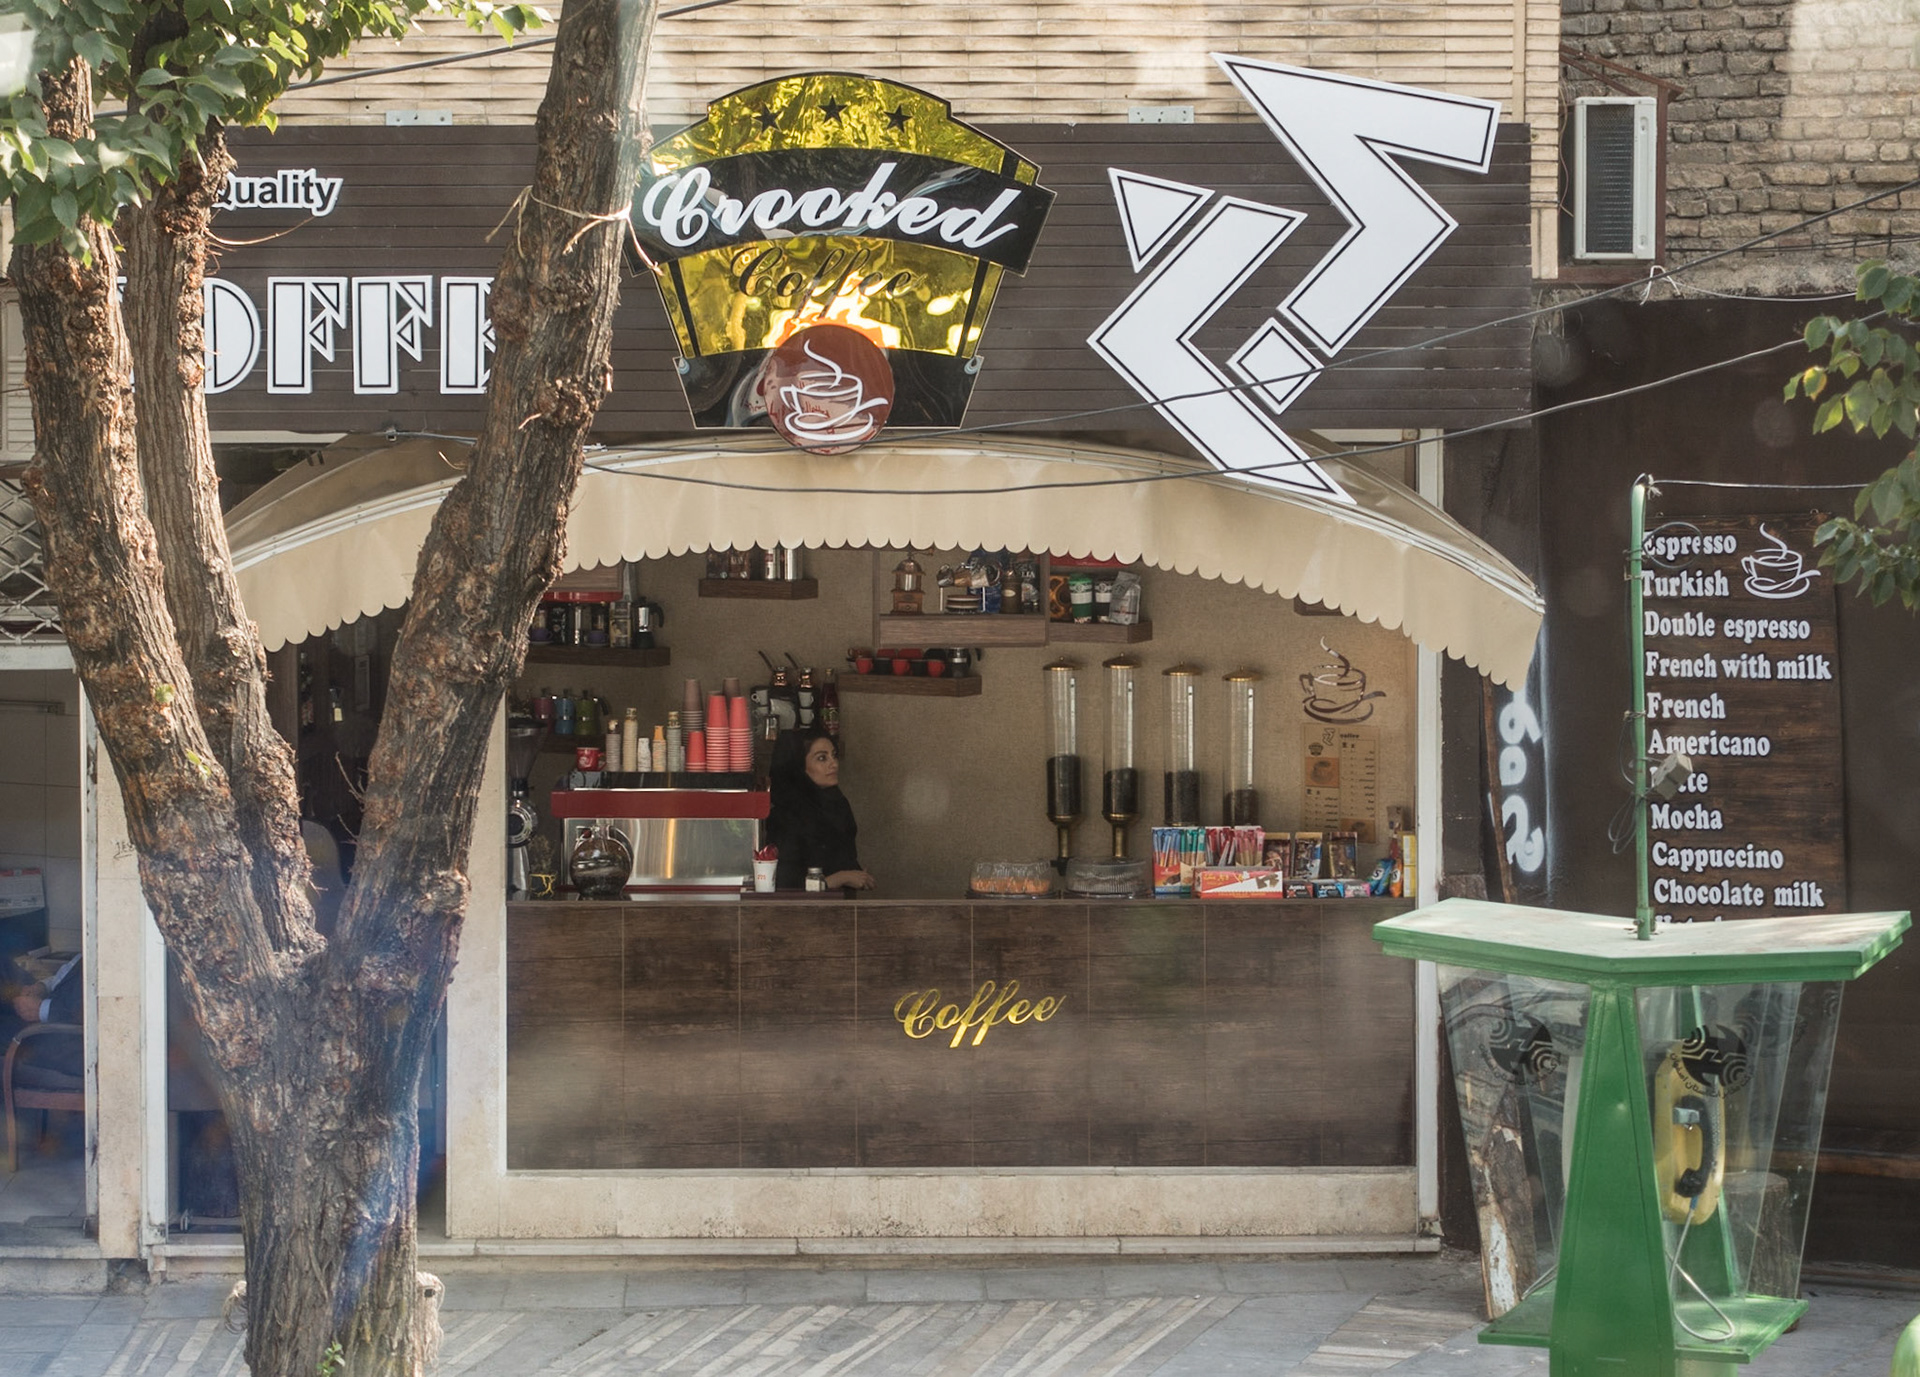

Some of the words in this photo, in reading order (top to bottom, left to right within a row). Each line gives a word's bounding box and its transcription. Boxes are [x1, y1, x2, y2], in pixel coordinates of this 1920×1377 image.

[642, 162, 1021, 248] Crooked
[730, 246, 927, 319] Coffee
[1642, 531, 1737, 561] Espresso
[1640, 569, 1729, 597] Turkish
[1644, 610, 1716, 637] Double
[1723, 618, 1811, 644] espresso
[1645, 651, 1718, 678] French
[1721, 653, 1772, 679] with
[1776, 654, 1832, 680] milk
[1646, 692, 1726, 719] French
[1648, 729, 1771, 756] Americano
[1650, 803, 1723, 830] Mocha
[1652, 841, 1784, 872] Cappuccino
[1654, 878, 1764, 906] Chocolate
[1774, 881, 1825, 907] milk
[893, 979, 1067, 1048] Coffee
